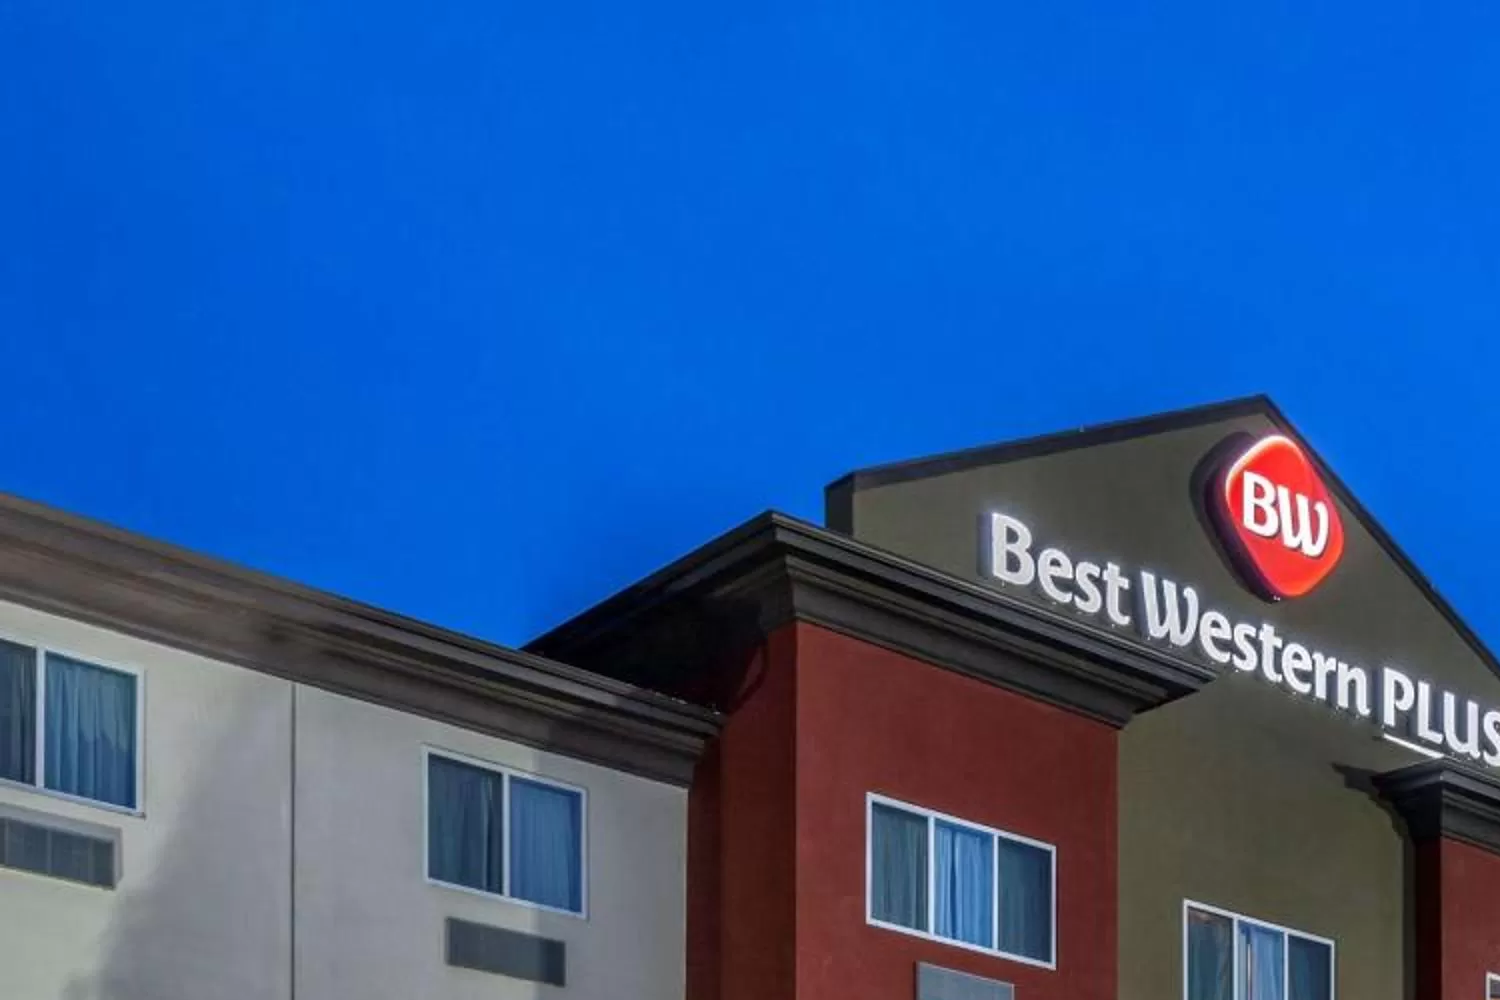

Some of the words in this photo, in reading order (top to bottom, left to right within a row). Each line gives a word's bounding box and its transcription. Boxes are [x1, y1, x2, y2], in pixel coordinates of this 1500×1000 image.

[1242, 471, 1329, 557] BW
[988, 512, 1130, 626] Best
[1140, 572, 1371, 717] Western
